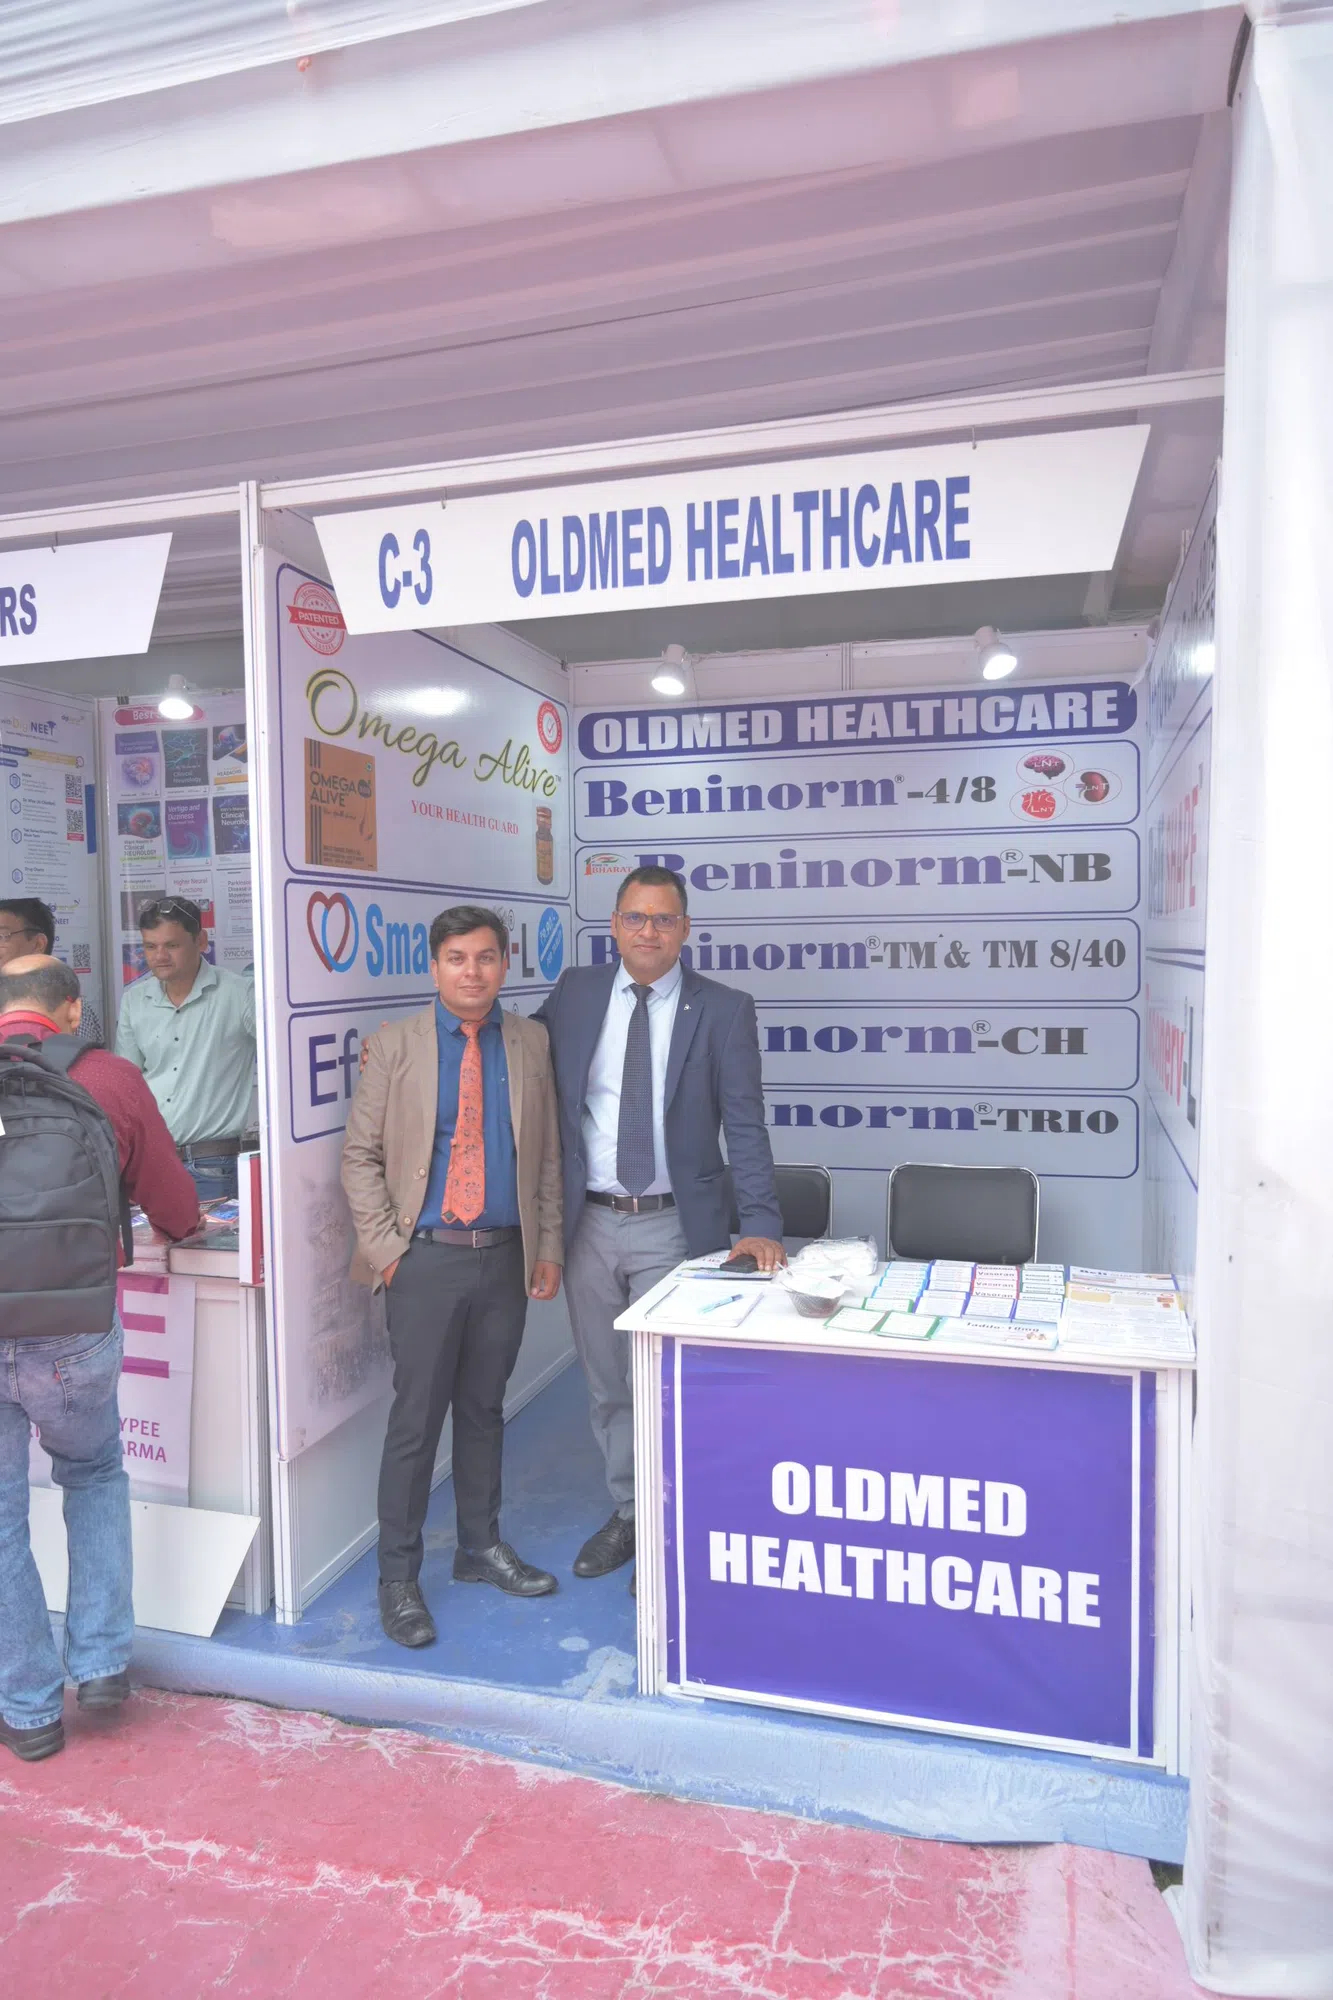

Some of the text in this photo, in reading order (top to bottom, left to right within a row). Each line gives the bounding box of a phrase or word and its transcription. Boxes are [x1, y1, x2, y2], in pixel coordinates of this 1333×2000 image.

[378, 475, 971, 609] C-3 OLDMED HEALTHCARE
[298, 611, 339, 625] PATENTED
[133, 710, 154, 721] Best
[592, 709, 783, 754] OLDMED
[796, 689, 1119, 744] HEALTHCARE
[306, 669, 467, 787] Omega
[310, 771, 357, 794] OMEGA
[168, 804, 188, 812] Vertigo
[311, 788, 345, 807] ALIVE
[221, 811, 244, 819] Clinical
[411, 800, 519, 836] YOUR HEALTH GUARD
[592, 866, 633, 874] BHARAT
[944, 940, 970, 969] &
[983, 939, 1038, 968] TM
[1050, 938, 1126, 971] 8/40
[121, 1417, 161, 1438] YPEE
[772, 1461, 1028, 1537] OLDMED
[709, 1530, 1101, 1628] HEALTHCARE
